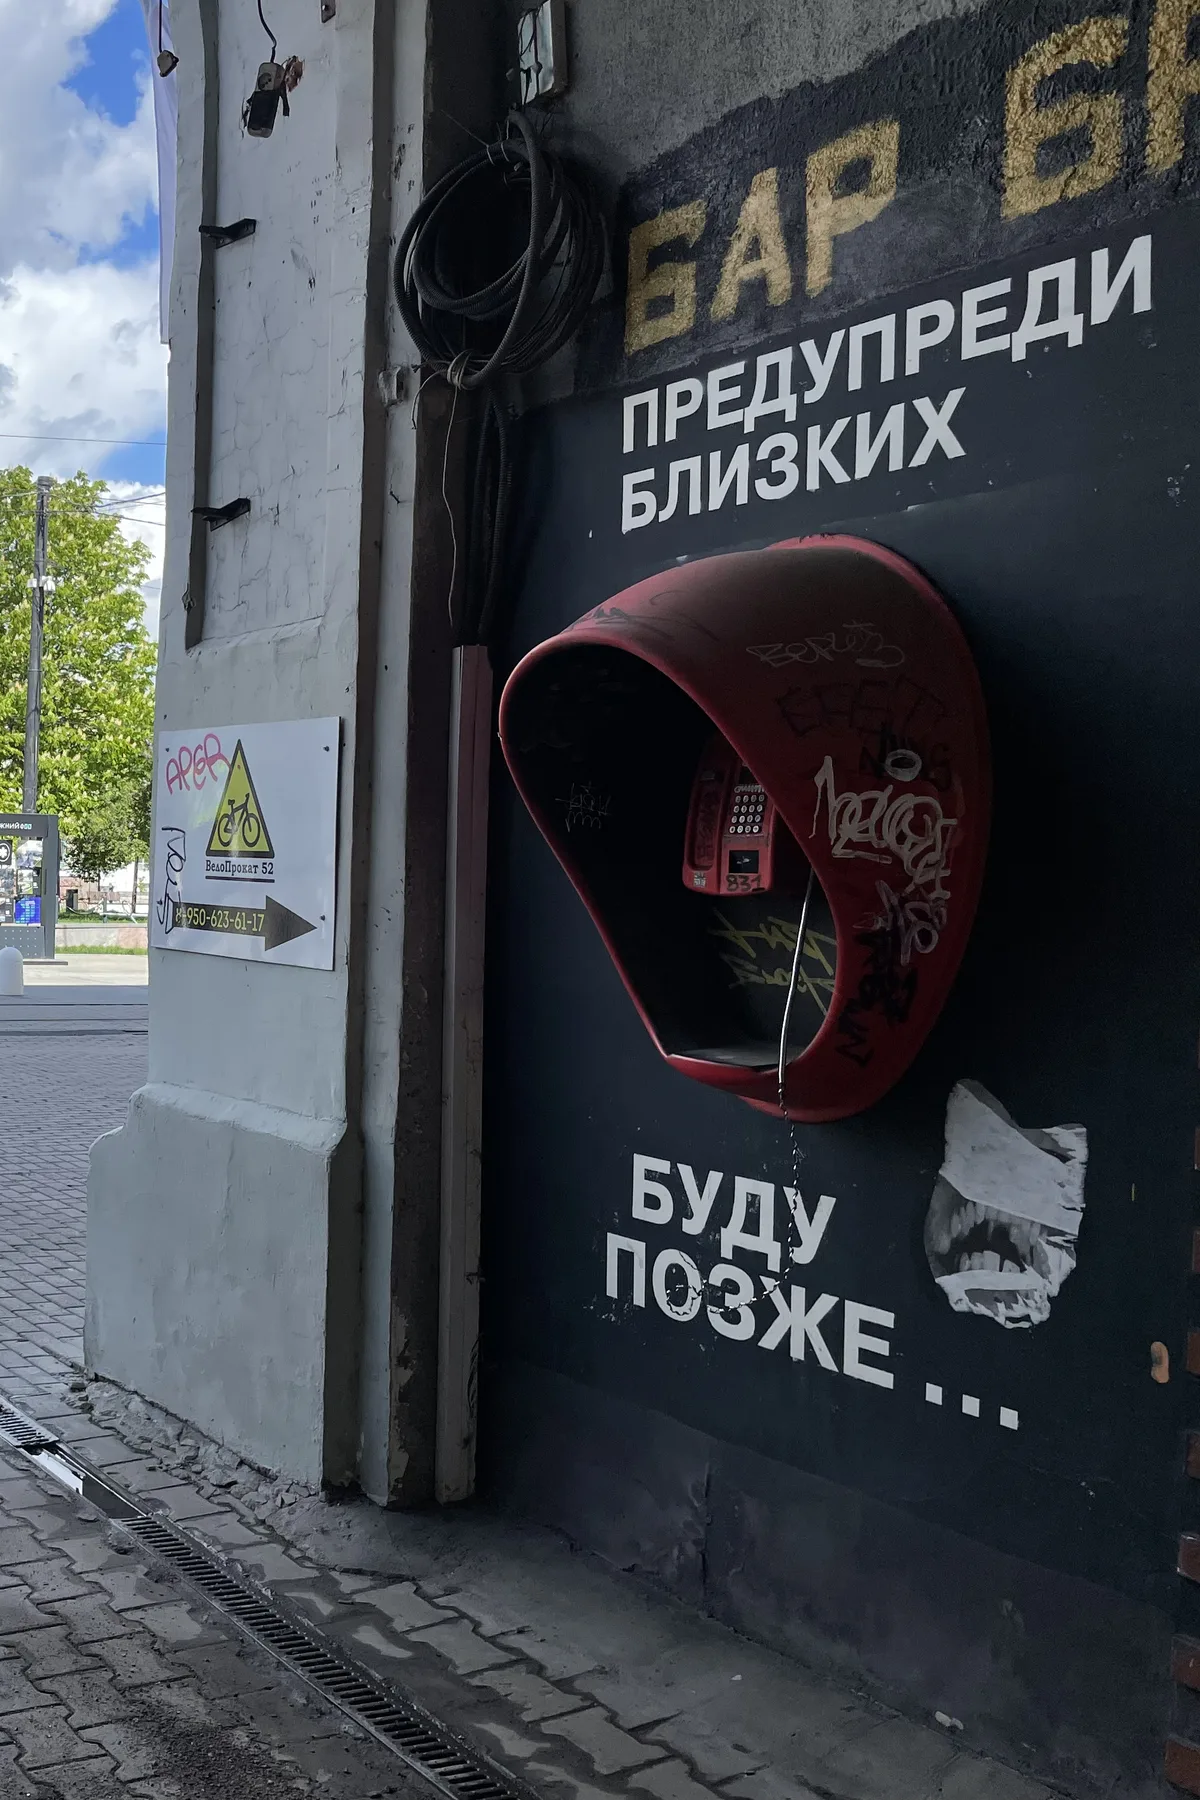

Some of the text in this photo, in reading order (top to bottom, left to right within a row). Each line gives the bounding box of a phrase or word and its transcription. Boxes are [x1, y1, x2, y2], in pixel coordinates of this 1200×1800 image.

[624, 119, 900, 355] БАР
[622, 234, 1153, 454] ПРЕДУПРЕДИ
[621, 386, 967, 535] БЛИЗКИХ
[175, 907, 265, 933] 8-950-623-61-17
[205, 859, 274, 876] ВелоПрокат 52
[631, 1152, 836, 1273] БУДУ
